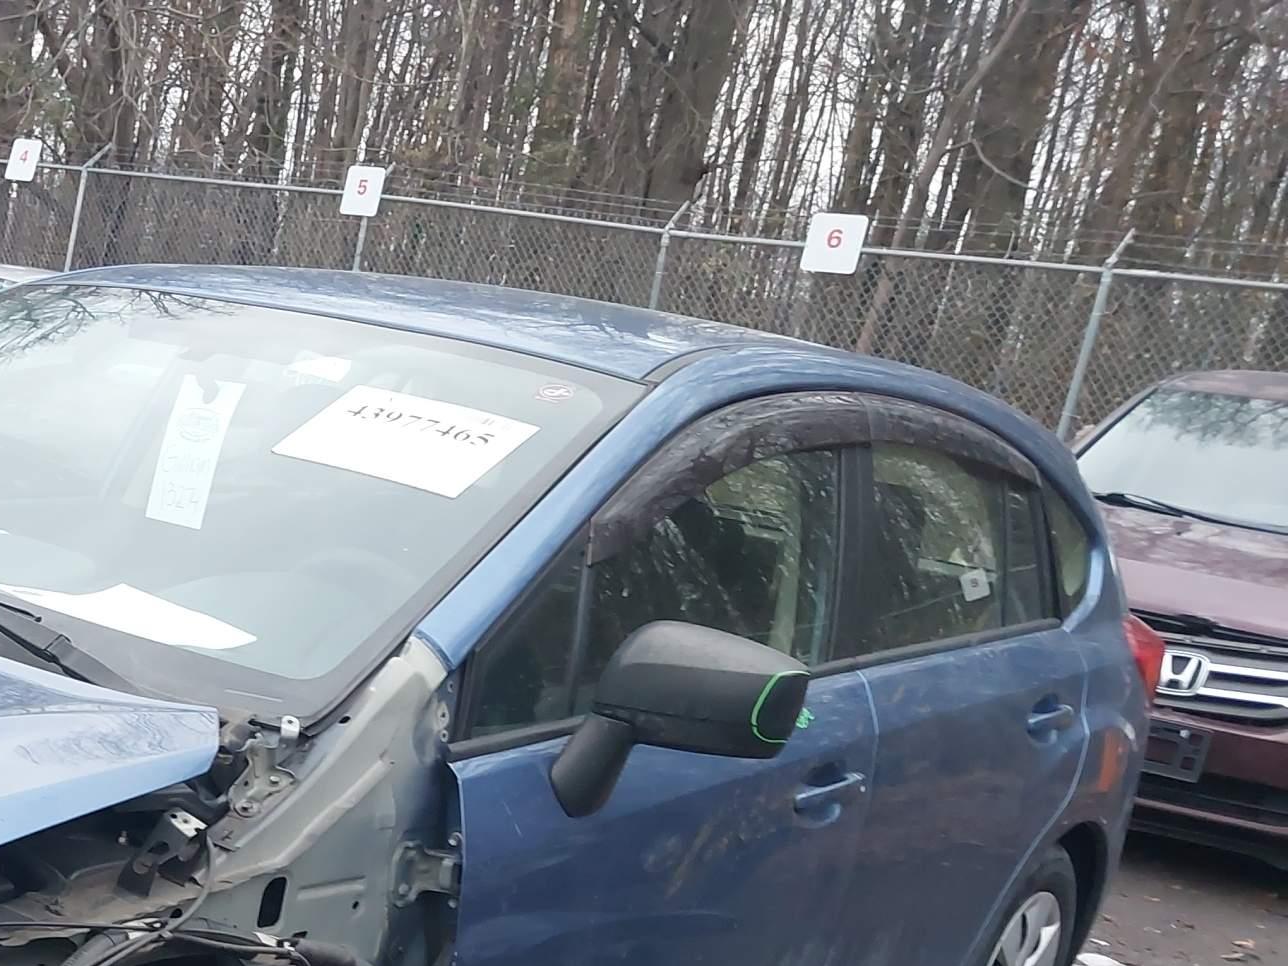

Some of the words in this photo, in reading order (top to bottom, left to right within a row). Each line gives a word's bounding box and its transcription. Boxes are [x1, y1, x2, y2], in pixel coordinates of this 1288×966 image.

[19, 149, 30, 164] 4
[356, 178, 369, 197] 5
[826, 227, 844, 249] 6
[346, 404, 496, 447] 43977465
